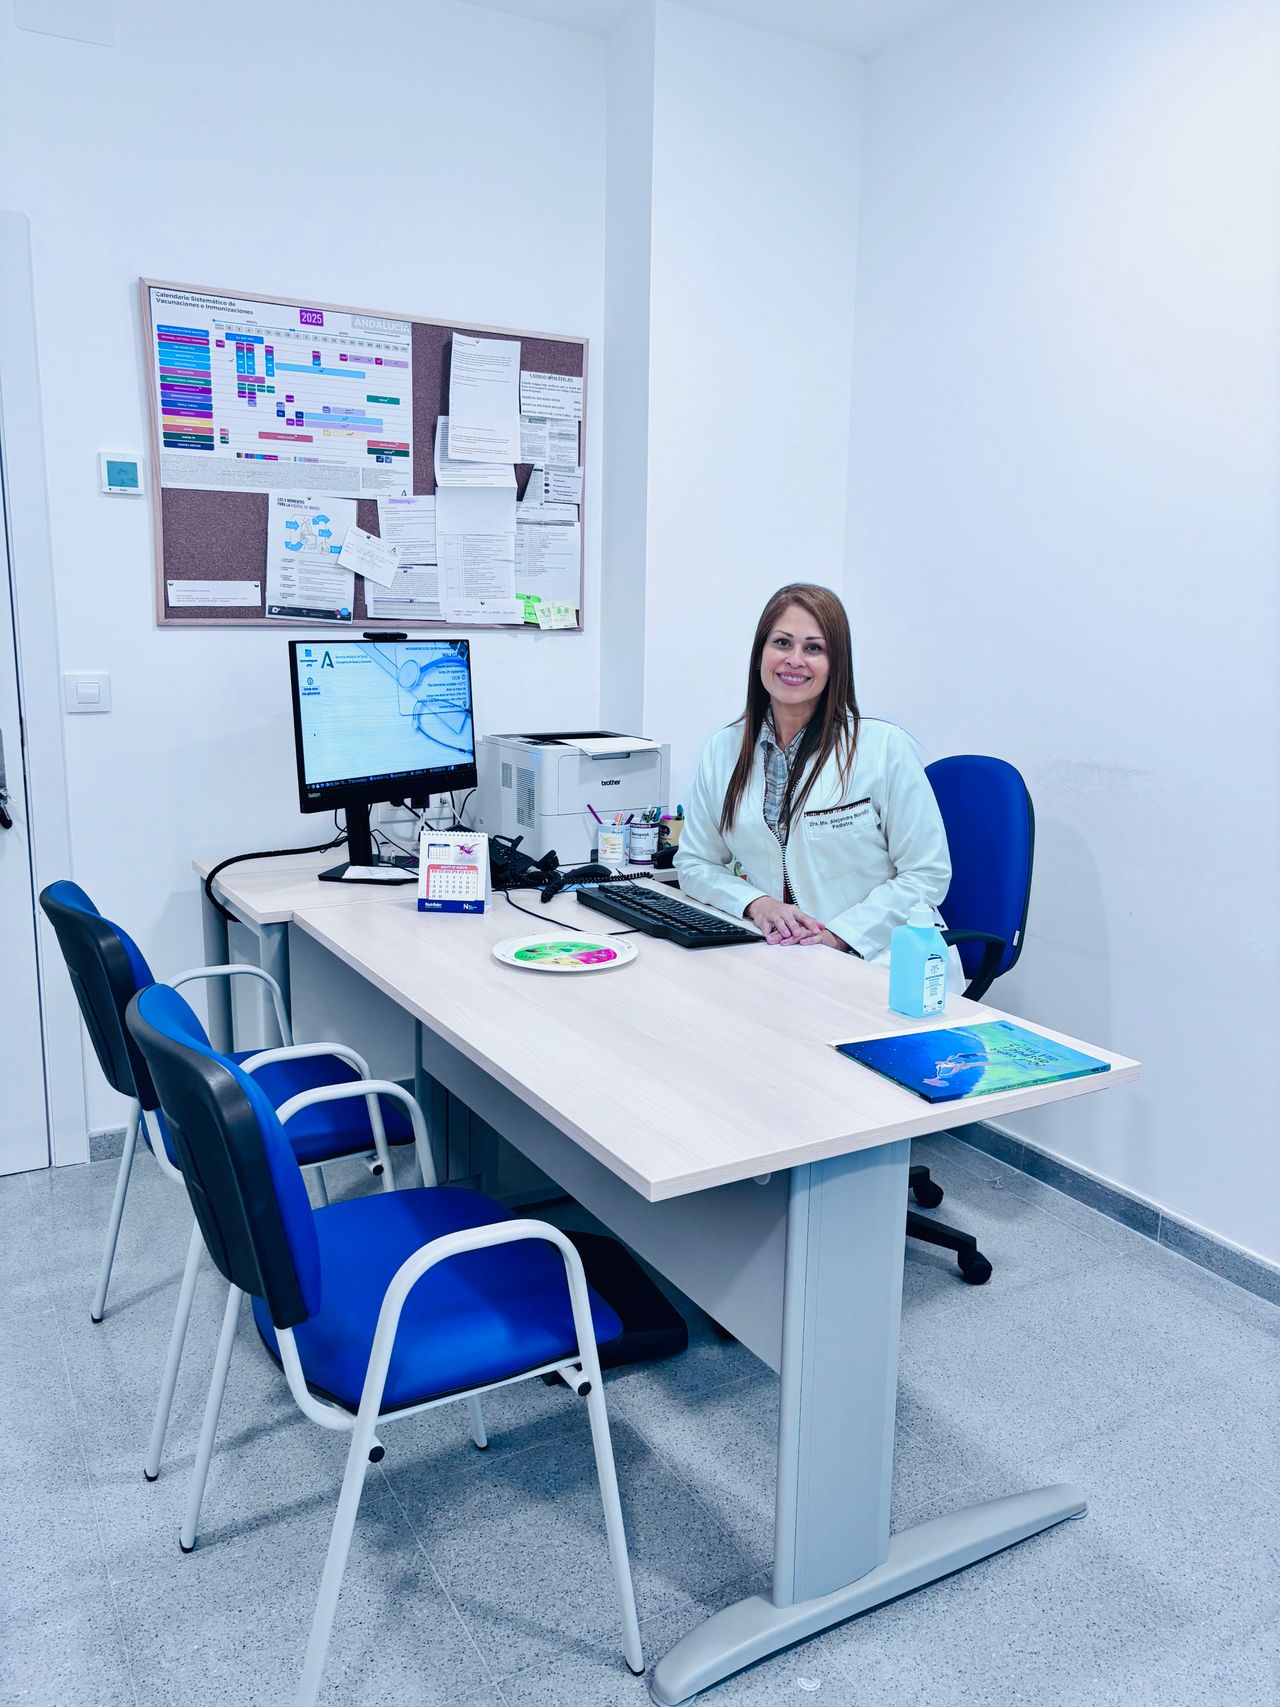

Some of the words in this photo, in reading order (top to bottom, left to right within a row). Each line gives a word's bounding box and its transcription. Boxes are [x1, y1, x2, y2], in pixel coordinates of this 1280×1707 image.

[156, 292, 189, 300] Calendario
[191, 296, 227, 306] Sistemático
[156, 298, 200, 308] Vacunaciones
[206, 304, 254, 315] Inmunizaciones
[302, 312, 322, 324] 2025
[354, 318, 410, 332] ANDALUCÍA
[832, 821, 853, 829] Pediatra
